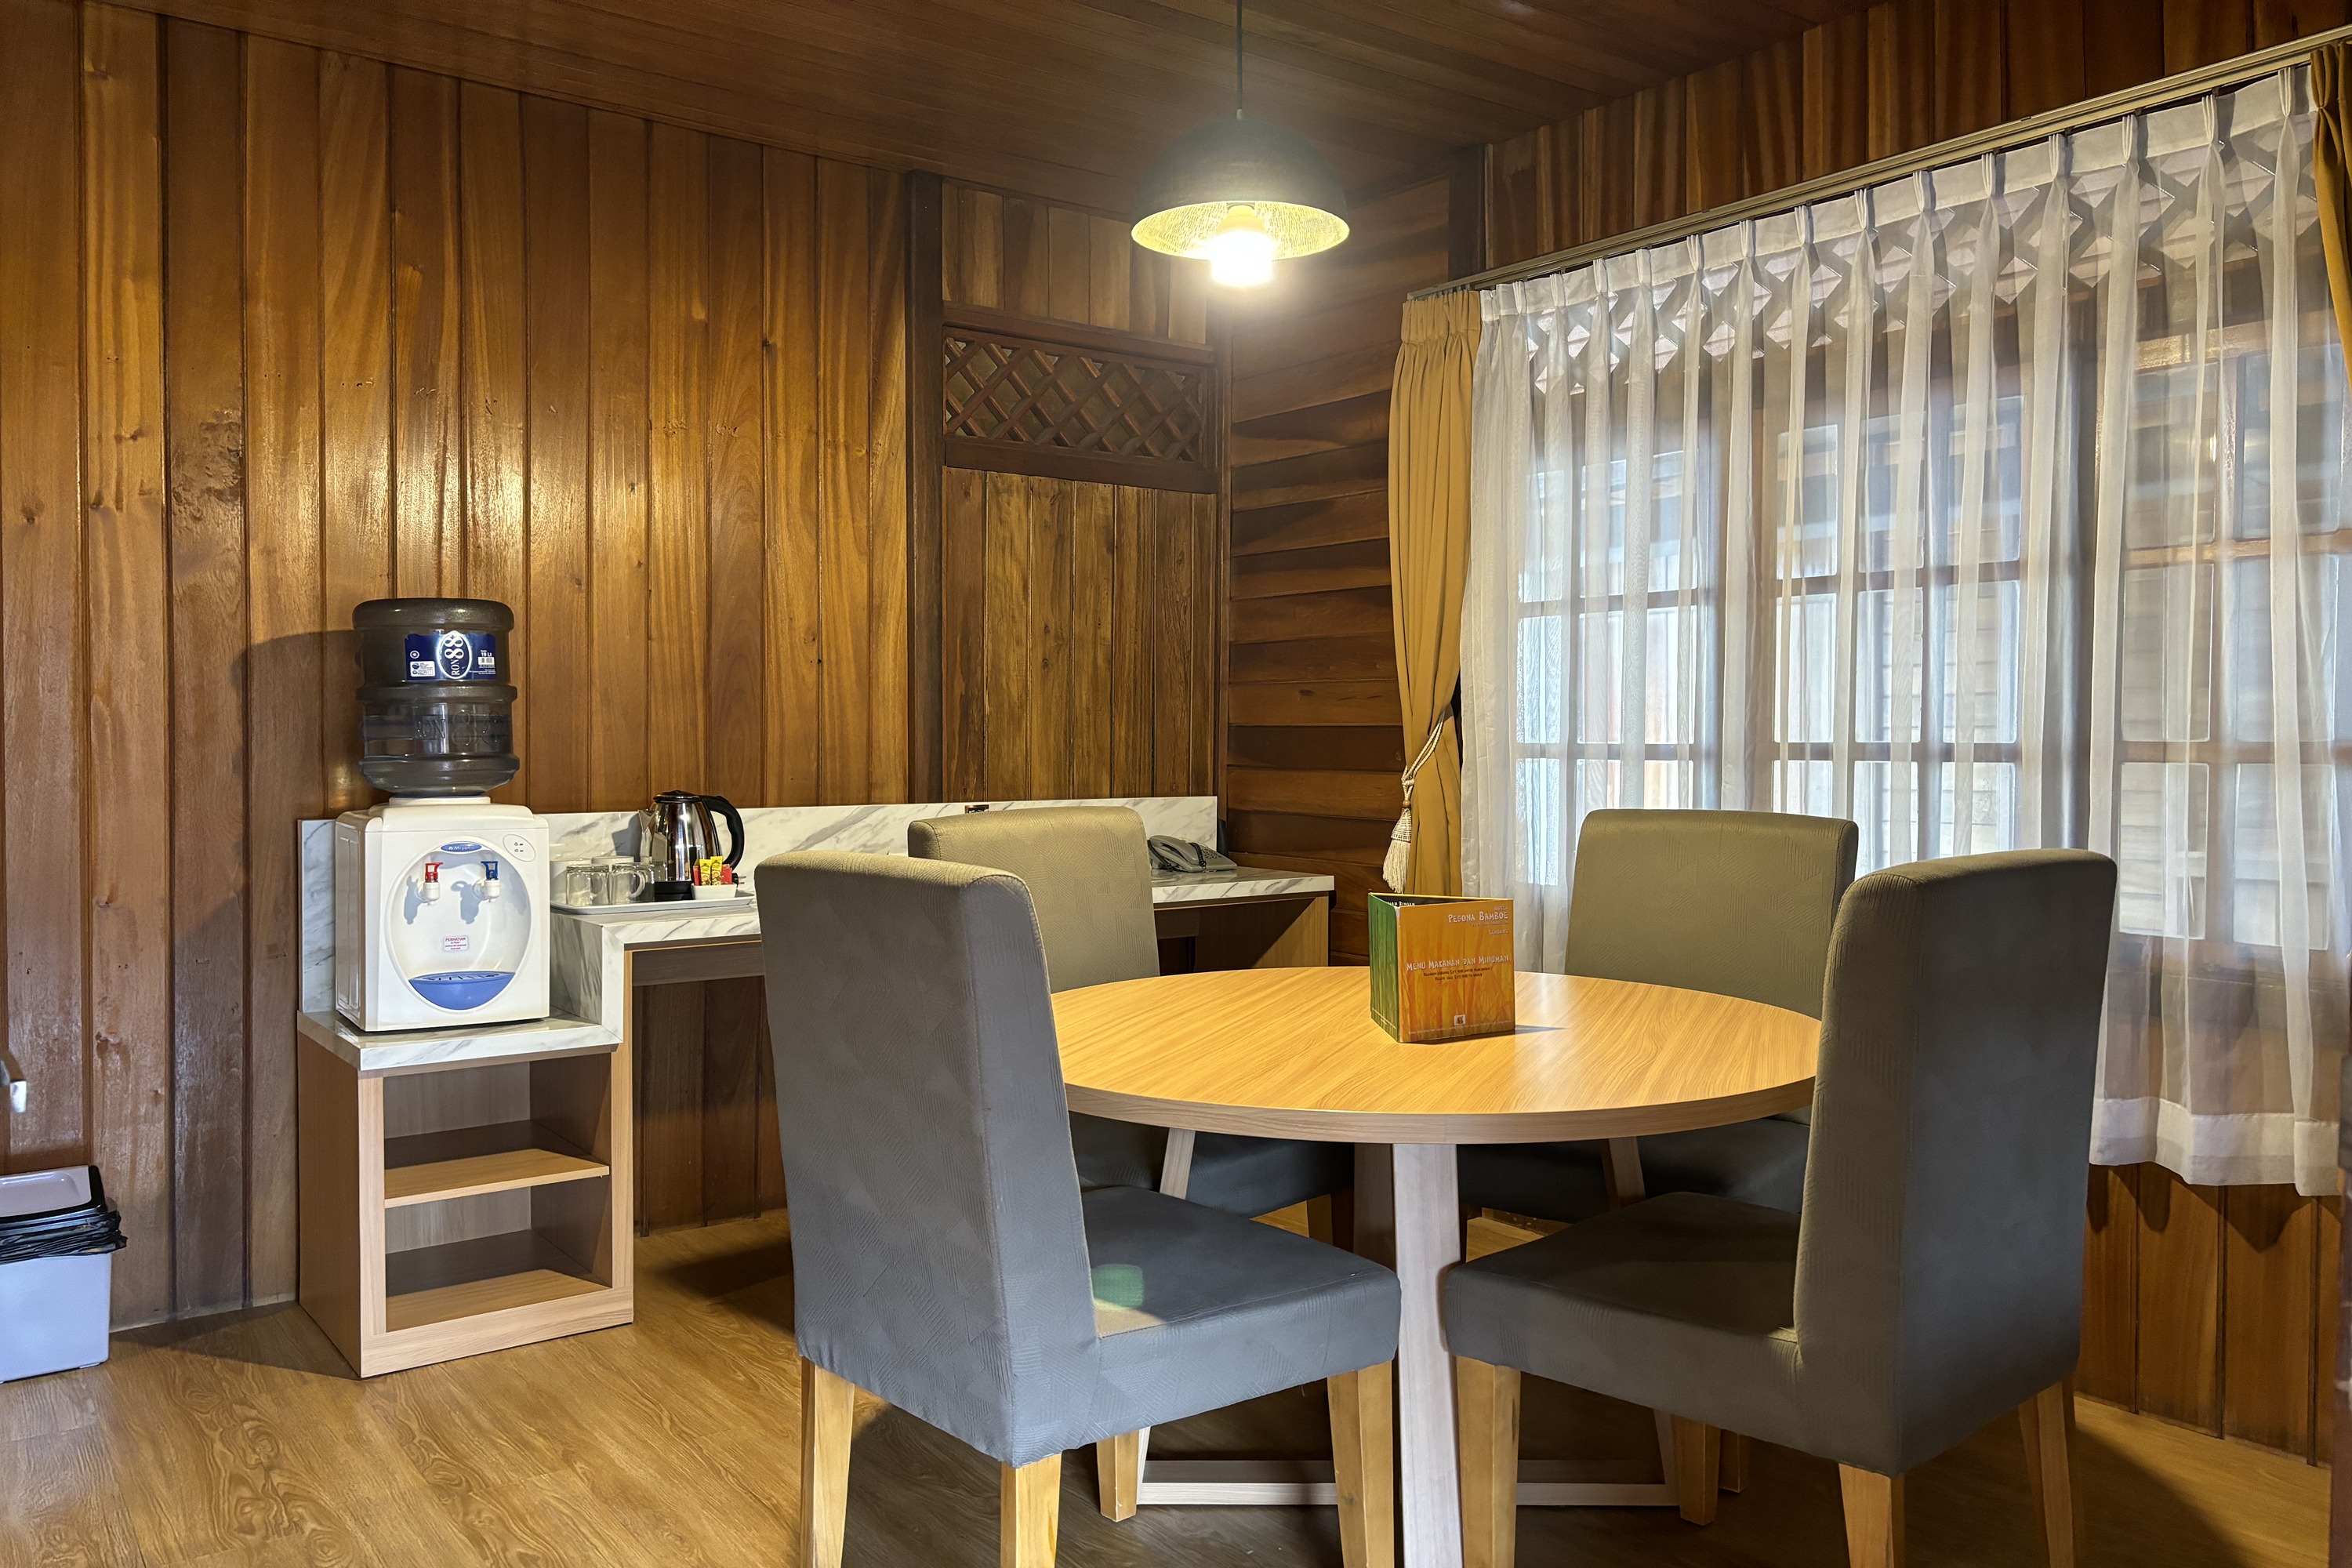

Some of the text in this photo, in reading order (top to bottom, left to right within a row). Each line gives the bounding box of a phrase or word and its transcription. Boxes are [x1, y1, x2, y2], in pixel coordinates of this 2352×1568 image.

[444, 634, 464, 675] RON 88
[1448, 912, 1508, 923] PESONA BAMBOE
[1407, 962, 1426, 971] MENU
[1428, 960, 1460, 969] MAKANAN
[1479, 954, 1509, 964] MINUMAN
